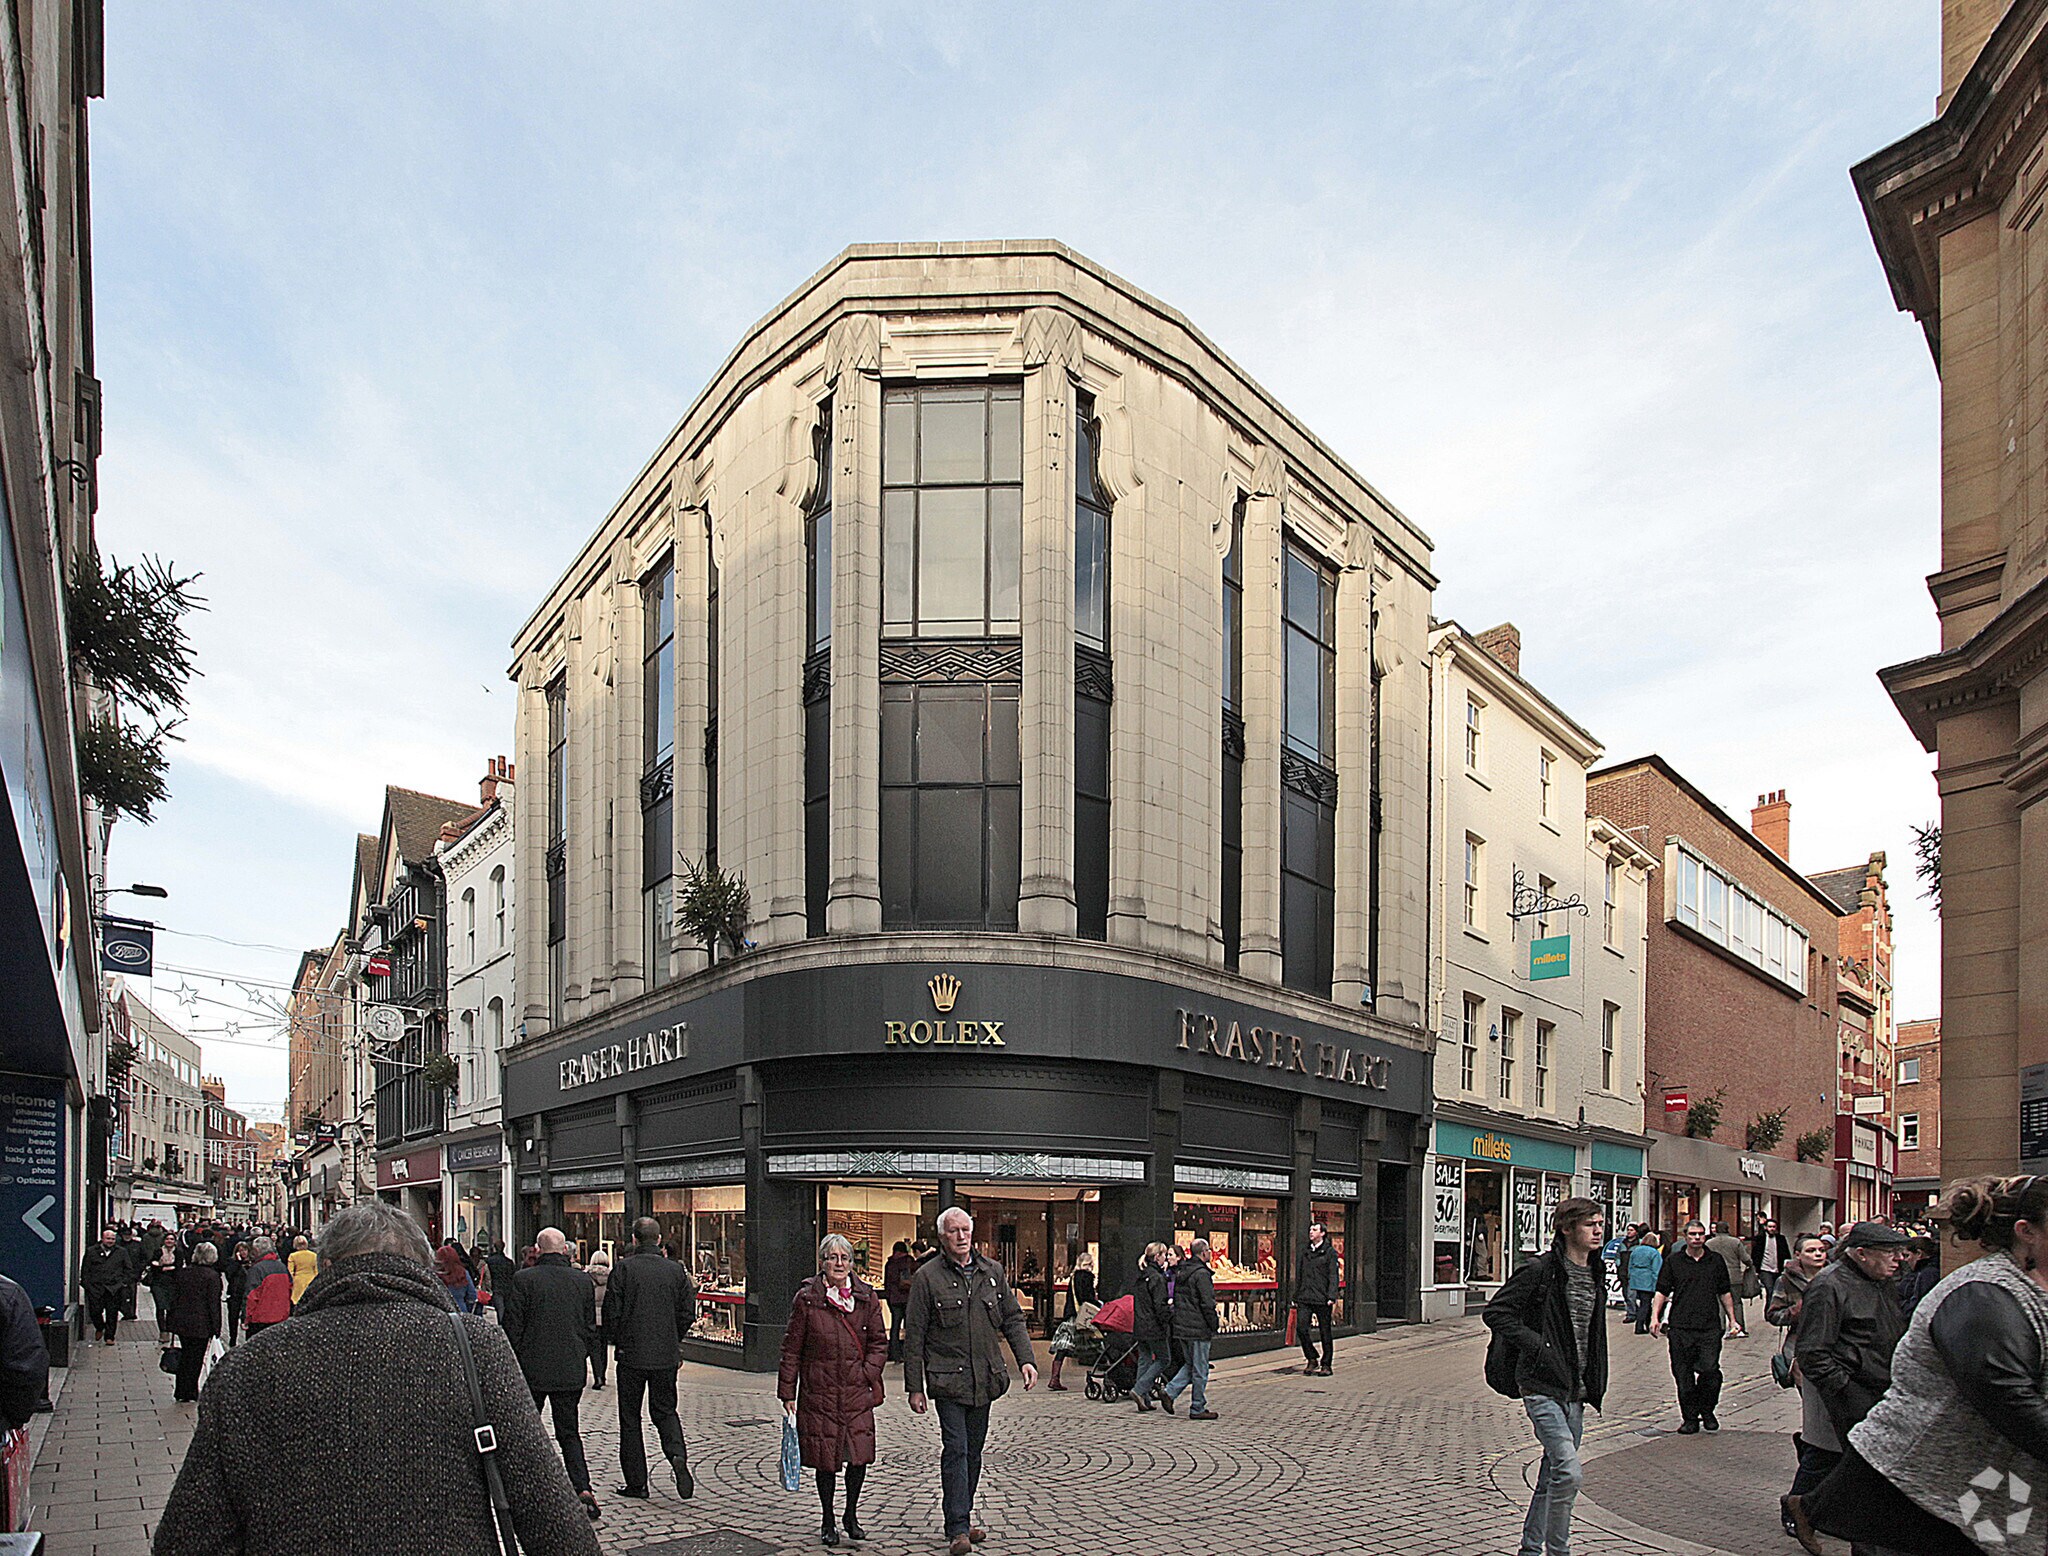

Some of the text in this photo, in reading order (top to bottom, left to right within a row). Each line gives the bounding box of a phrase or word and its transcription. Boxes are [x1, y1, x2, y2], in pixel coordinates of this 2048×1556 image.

[1533, 953, 1567, 965] millets
[884, 1019, 1006, 1046] ROLEX
[1176, 1007, 1393, 1092] FRASER HART
[559, 1021, 689, 1091] FRASER HART
[15, 1108, 56, 1119] pharmacy
[12, 1117, 56, 1128] healthcare
[6, 1126, 56, 1137] hearingcare
[28, 1138, 56, 1148] beauty
[1473, 1132, 1511, 1161] millets
[5, 1145, 25, 1154] food
[35, 1148, 56, 1156] drink
[5, 1155, 56, 1166] baby & child
[31, 1167, 56, 1175] photo
[1435, 1164, 1461, 1186] SALE
[16, 1176, 56, 1186] Opticians
[1516, 1183, 1537, 1202] SALE
[1545, 1186, 1560, 1205] ALE
